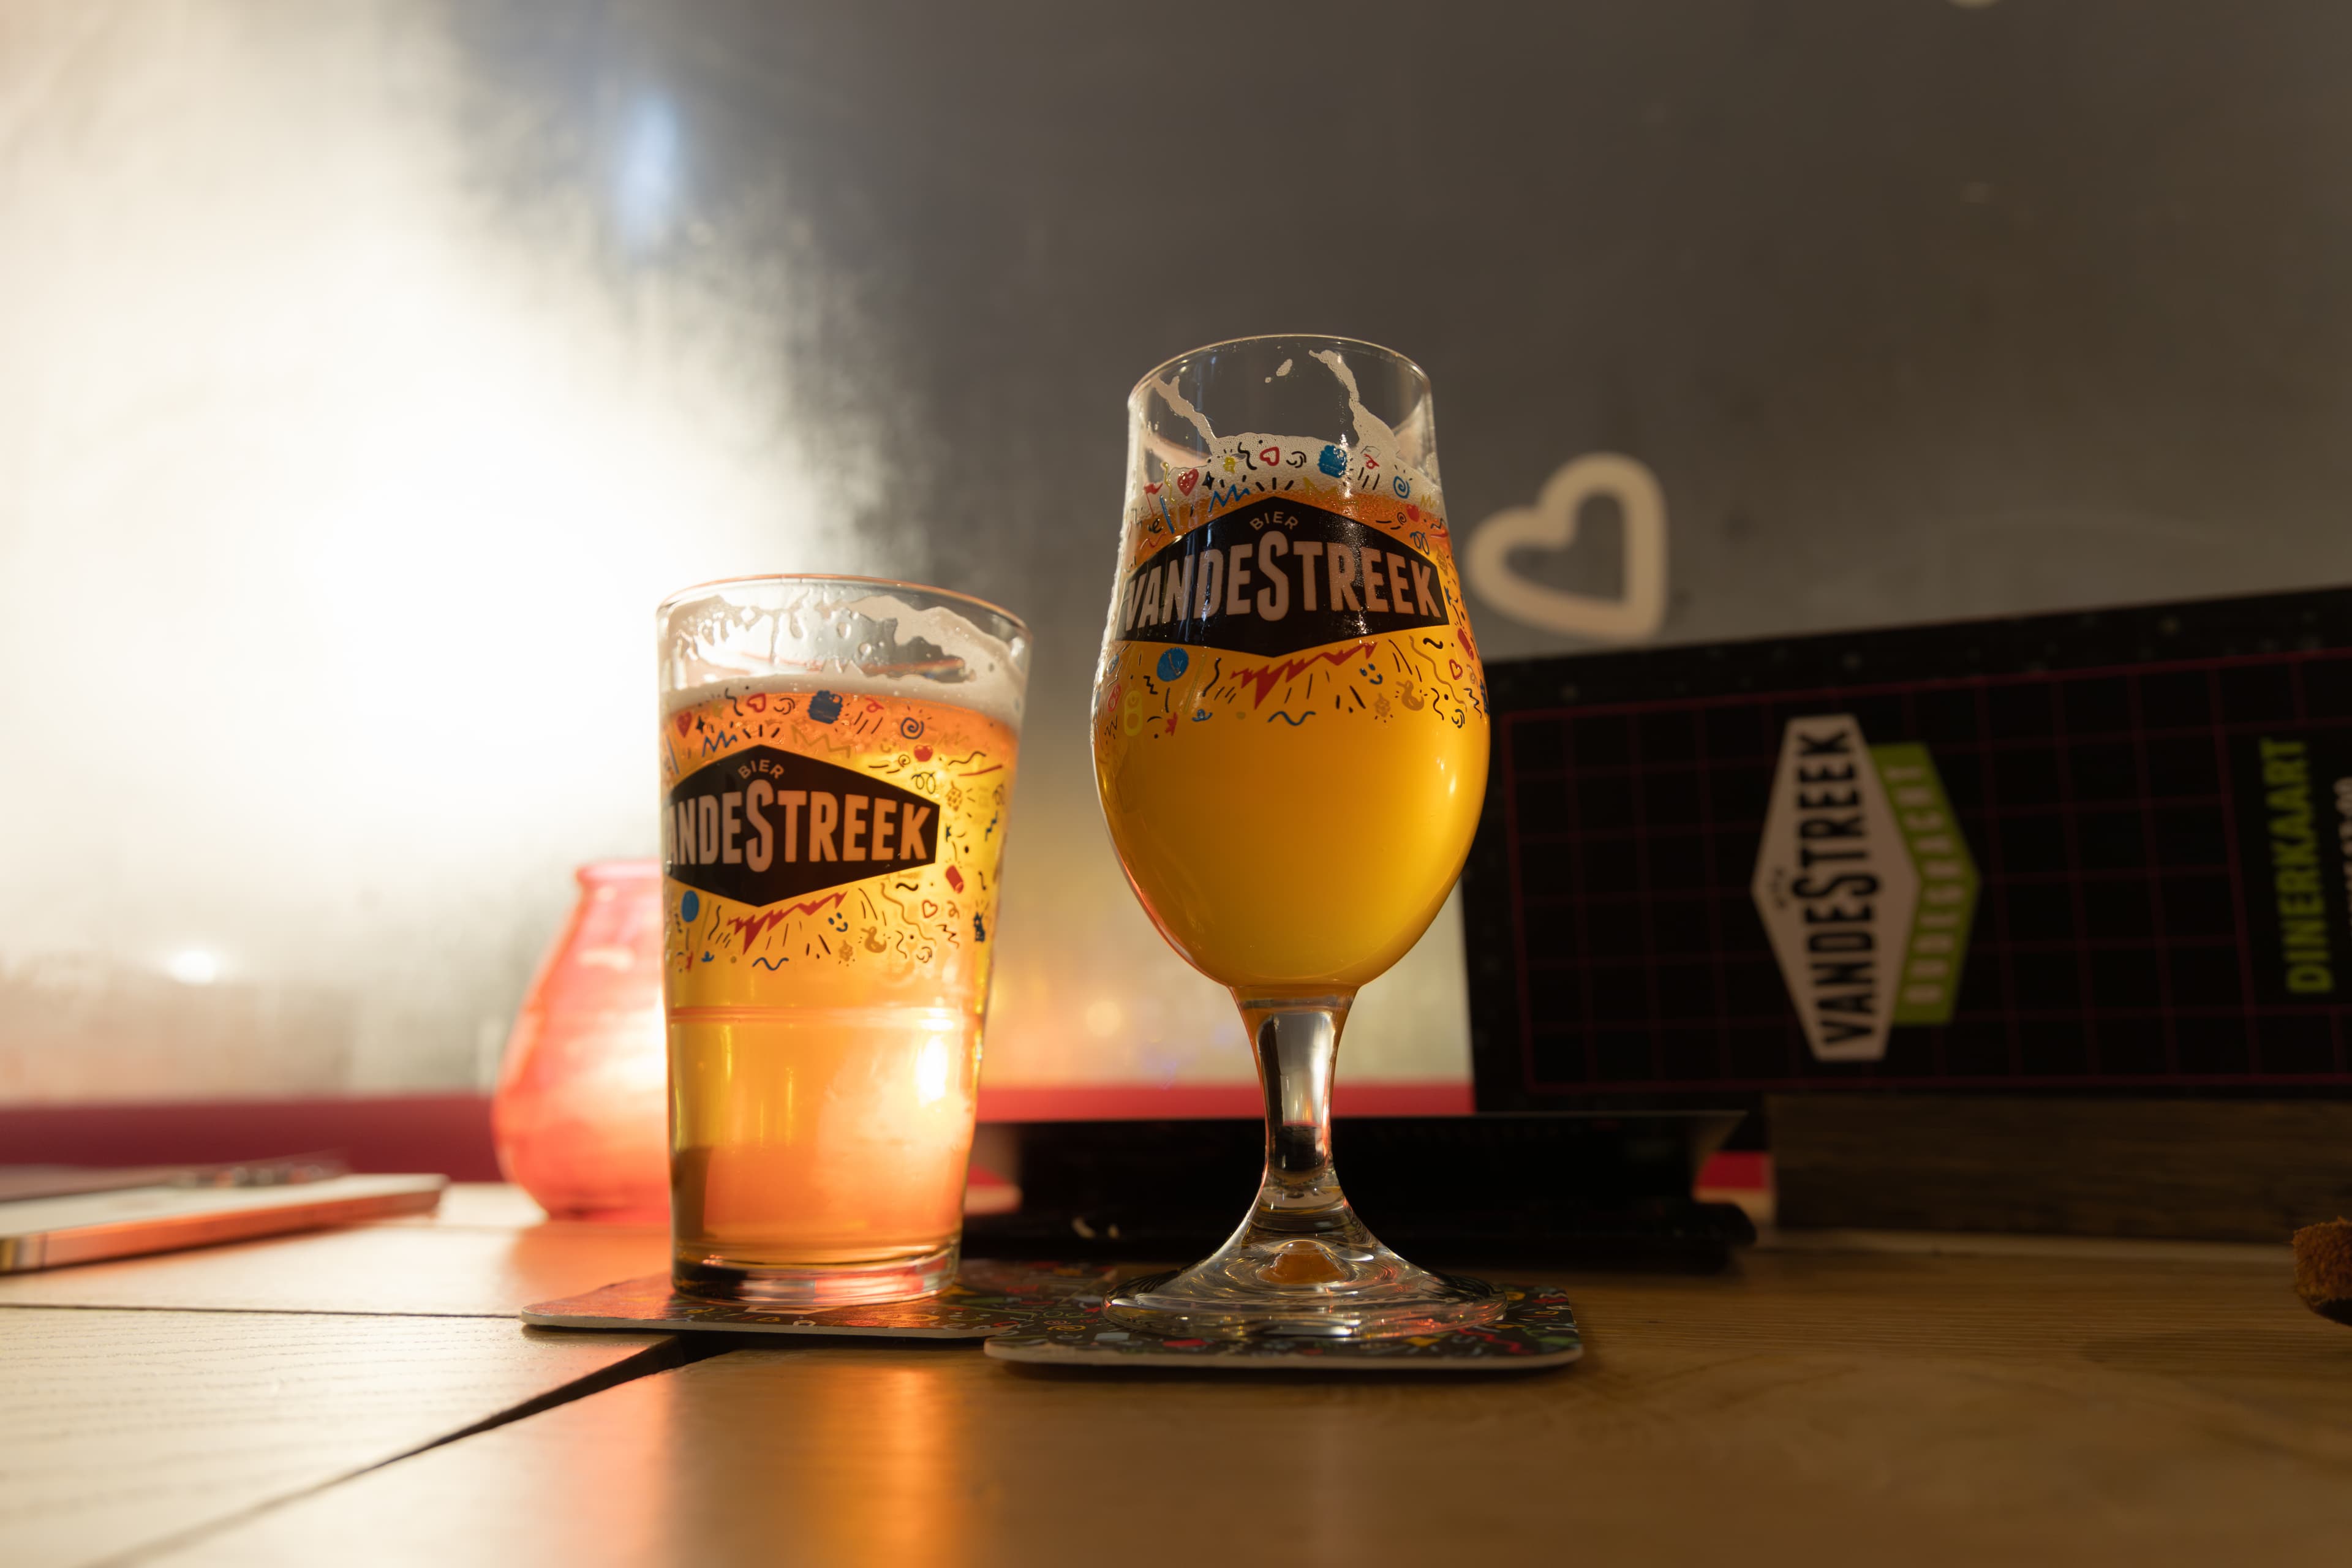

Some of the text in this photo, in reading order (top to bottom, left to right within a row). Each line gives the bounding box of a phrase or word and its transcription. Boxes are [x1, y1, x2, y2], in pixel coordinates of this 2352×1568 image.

[1251, 512, 1299, 530] BIER
[1126, 532, 1441, 631] VANDESTREEK
[738, 760, 784, 778] BIER
[667, 780, 930, 872] ANDESTREEK
[2260, 739, 2332, 992] DINERKAART
[1793, 729, 1879, 1045] VANDESTREEK
